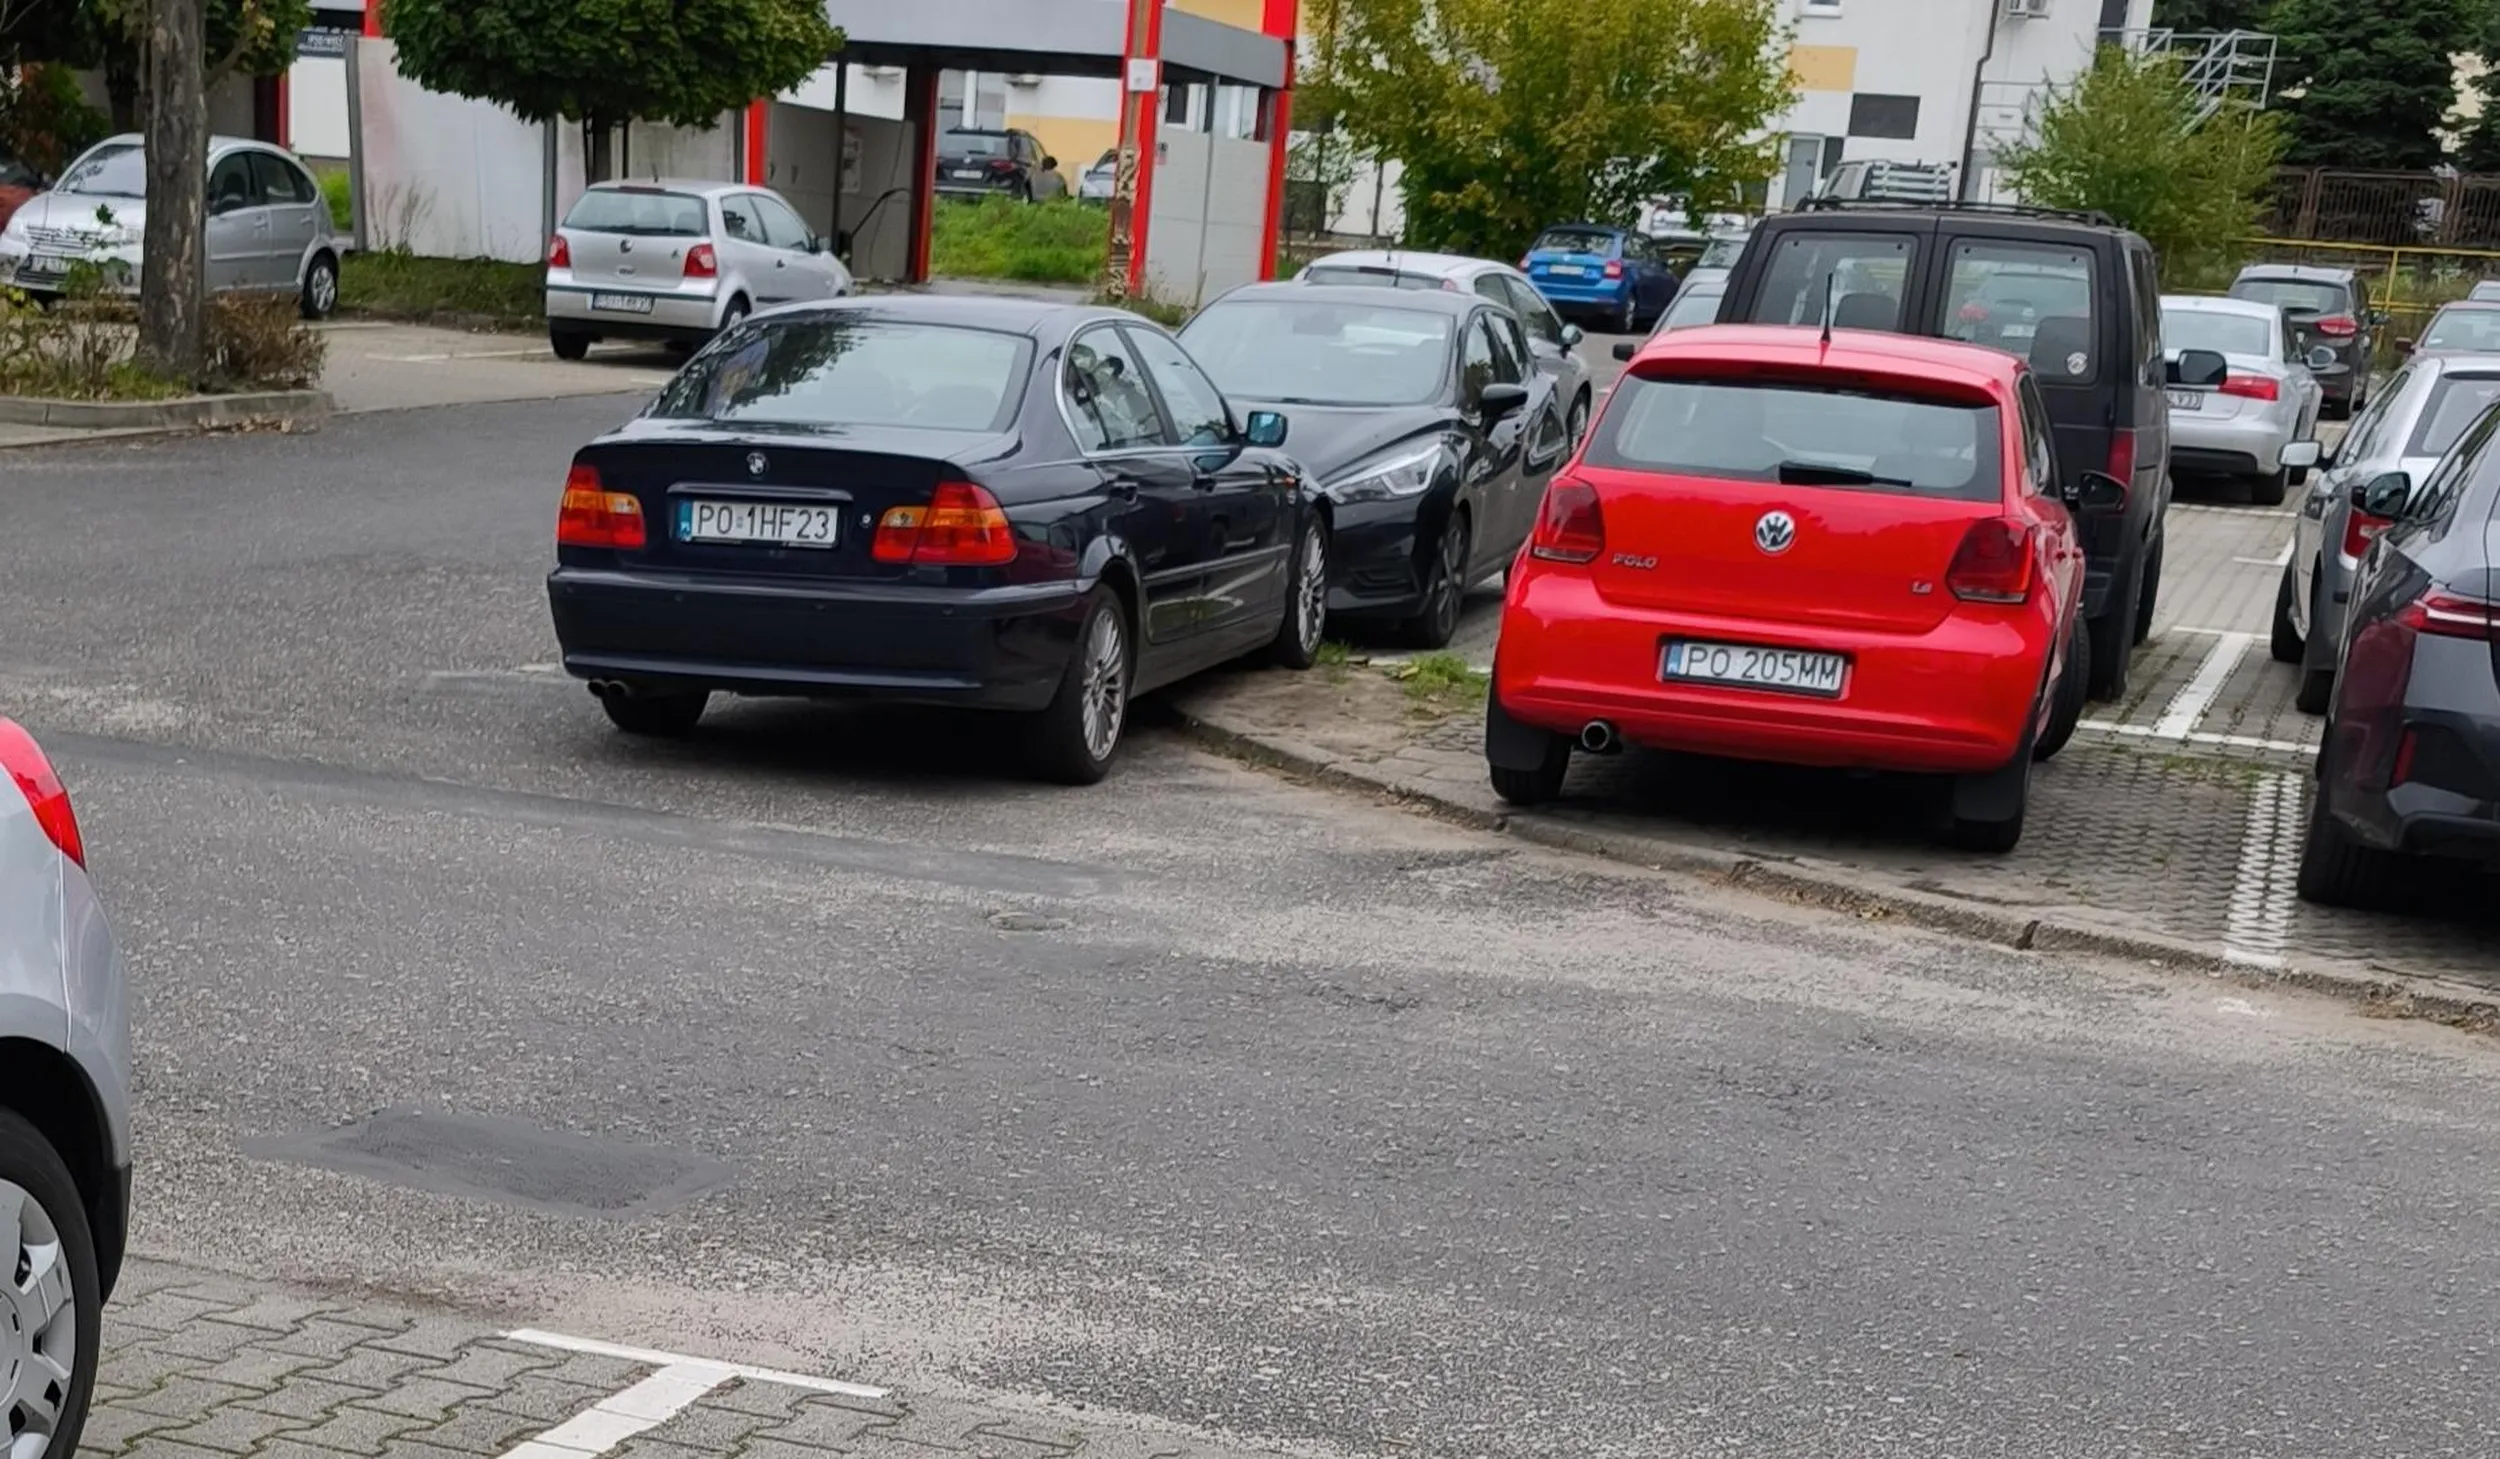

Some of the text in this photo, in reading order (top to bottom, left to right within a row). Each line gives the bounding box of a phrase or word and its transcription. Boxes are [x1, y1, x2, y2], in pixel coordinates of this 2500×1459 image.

[698, 504, 830, 540] PO 1HF23
[1612, 553, 1658, 569] POLO
[1685, 646, 1840, 688] PO 205MM
